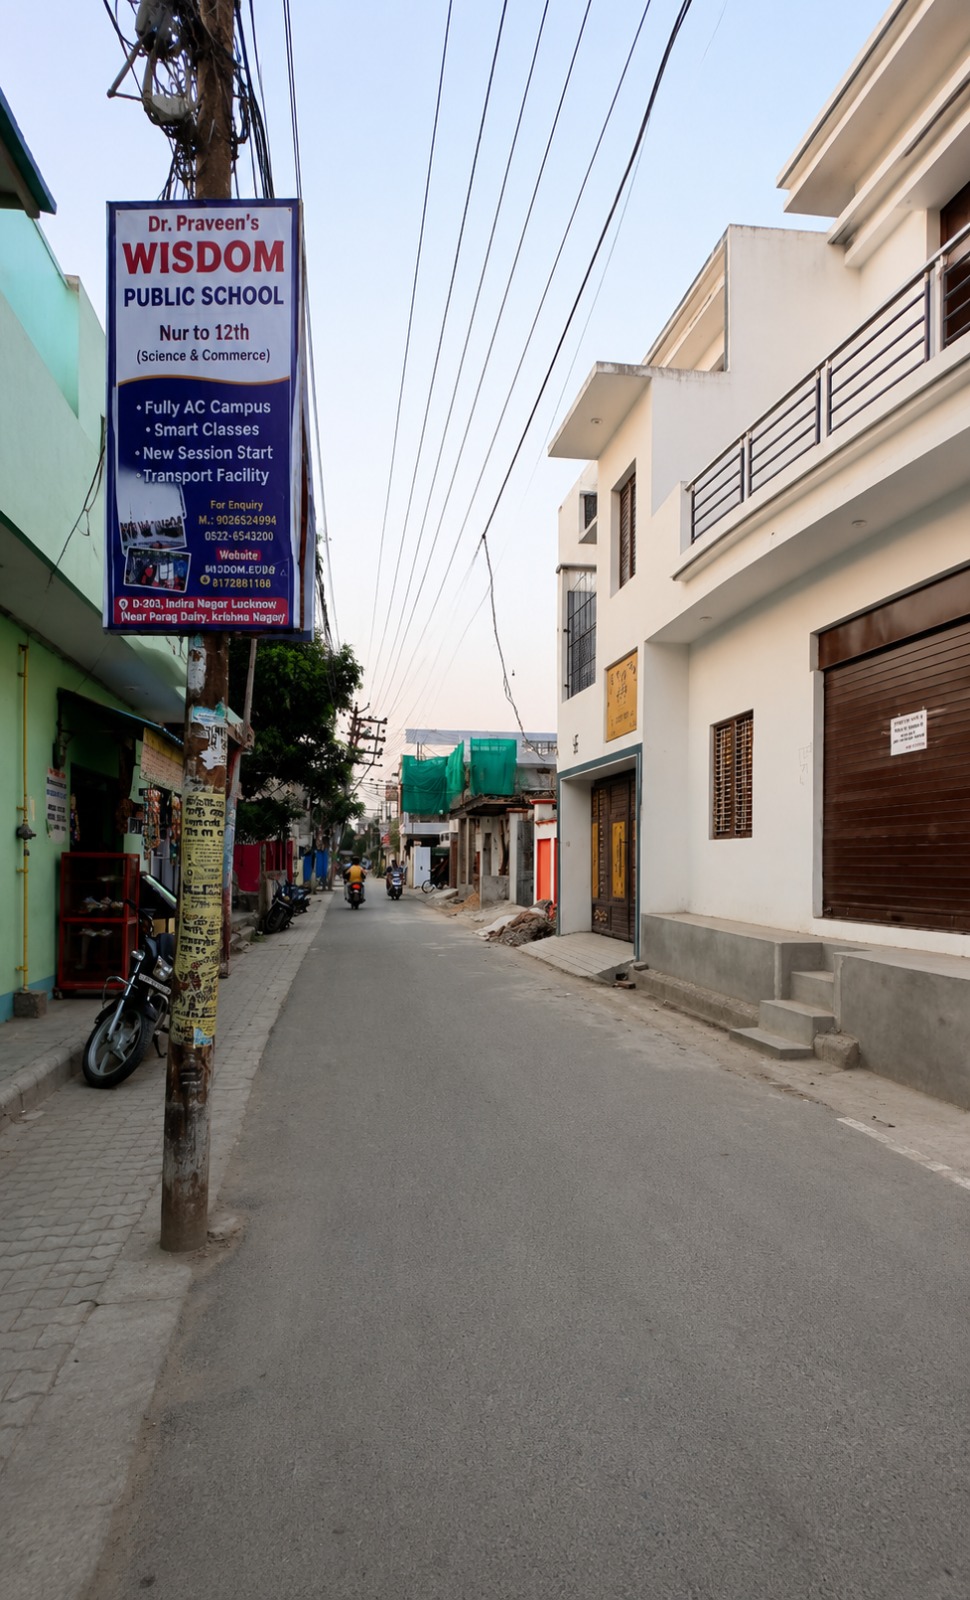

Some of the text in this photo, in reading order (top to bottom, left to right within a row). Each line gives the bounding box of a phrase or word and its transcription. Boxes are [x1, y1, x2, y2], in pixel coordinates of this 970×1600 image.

[148, 213, 259, 232] Dr. Praveen's
[122, 239, 285, 275] WISDOM
[124, 285, 284, 307] PUBLIC SCHOOL
[159, 323, 250, 341] Nur to 12th
[136, 348, 270, 364] (Science & Commerce)
[145, 400, 271, 418] Fully AC Campus
[154, 422, 259, 437] Smart Classes
[143, 445, 273, 460] New Session Start
[143, 468, 269, 485] Transport Facility
[210, 499, 264, 512] For Enquiry
[231, 598, 277, 609] Lucknow
